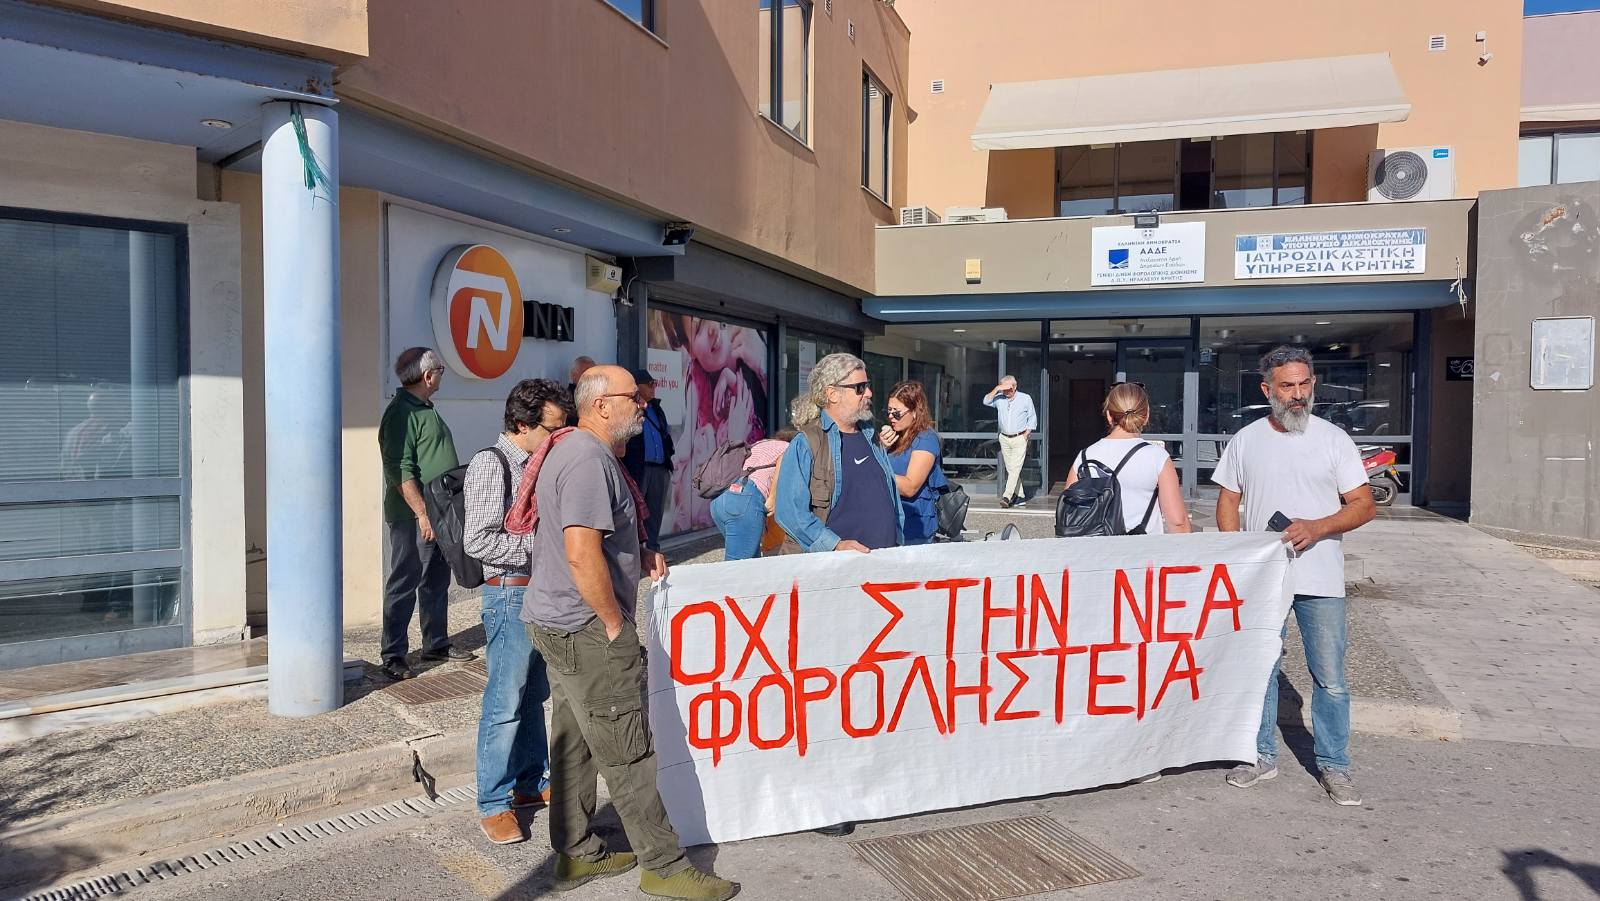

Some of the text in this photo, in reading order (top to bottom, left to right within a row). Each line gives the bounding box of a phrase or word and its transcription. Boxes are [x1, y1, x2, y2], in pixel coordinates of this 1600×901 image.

[1139, 246, 1168, 255] ΑΑΔΕ
[1246, 247, 1415, 263] ΙΑΤΡΟΔΙΚΑΣΤΙΚΗ
[1246, 259, 1415, 274] ΥΠΗΡΕΣΙΑ ΚΡΗΤΗΣ
[528, 300, 575, 342] NN
[670, 561, 1244, 686] ΟΧΙ ΣΤΗΝ ΝΕΑ
[689, 640, 1204, 767] ΦΟΡΟΛΗΣΤΕΙΑ
